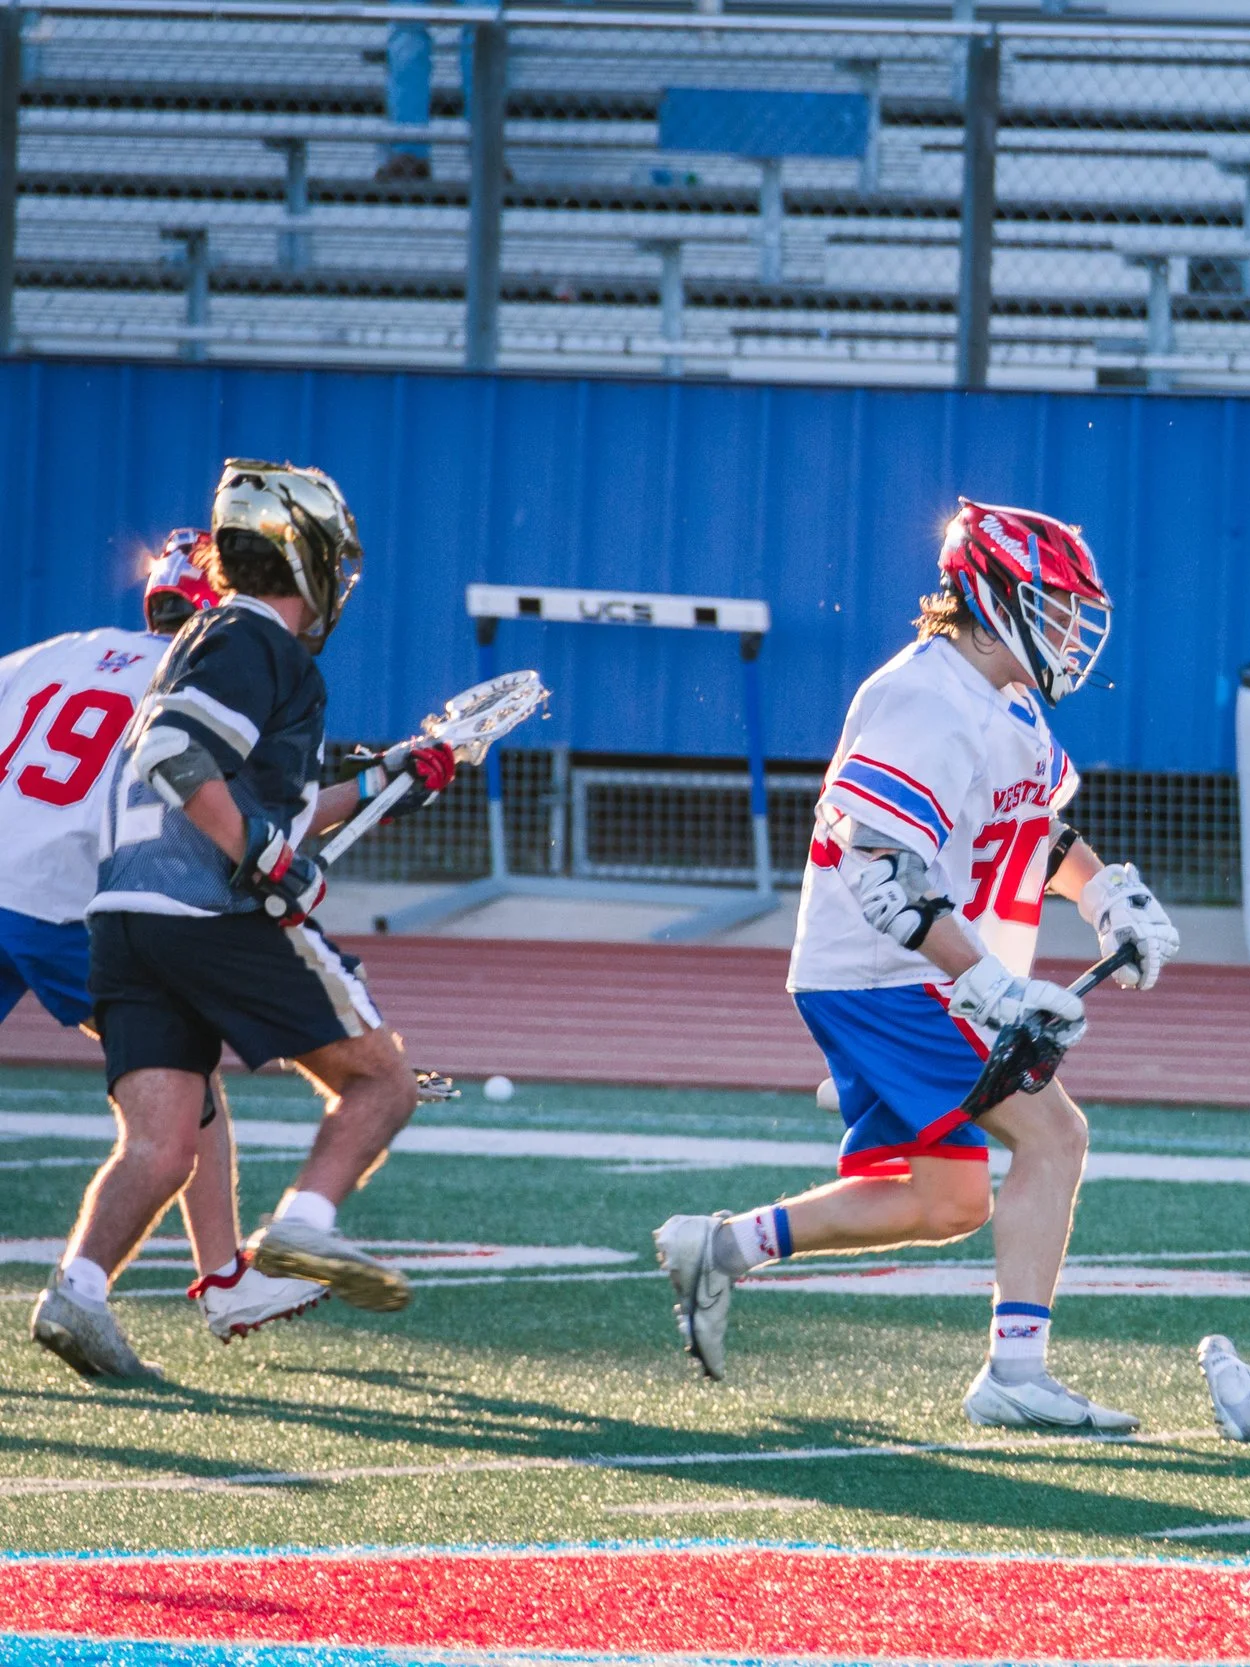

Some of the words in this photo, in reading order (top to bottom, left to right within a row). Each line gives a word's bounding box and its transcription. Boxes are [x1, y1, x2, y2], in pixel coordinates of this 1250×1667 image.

[578, 599, 652, 623] UCS
[0, 681, 135, 808] 19
[992, 779, 1051, 817] WESTL
[961, 815, 1050, 927] 30
